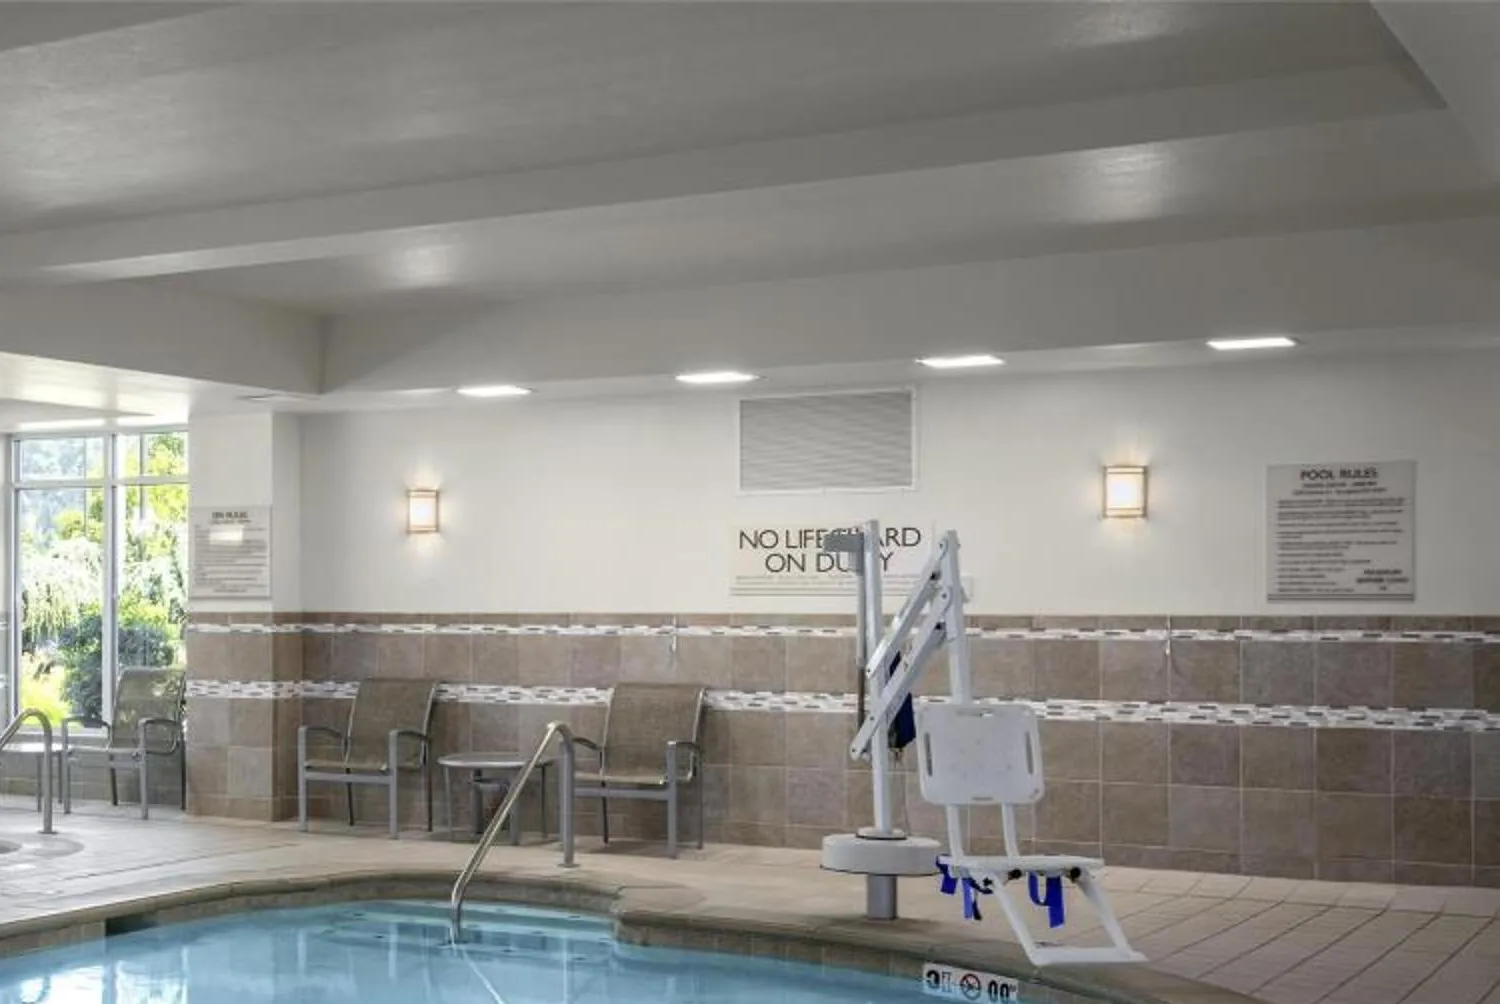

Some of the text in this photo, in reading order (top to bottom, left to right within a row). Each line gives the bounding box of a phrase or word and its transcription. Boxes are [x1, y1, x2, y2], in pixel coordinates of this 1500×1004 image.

[739, 527, 921, 549] NO LIFERD
[765, 552, 893, 573] ON DUY
